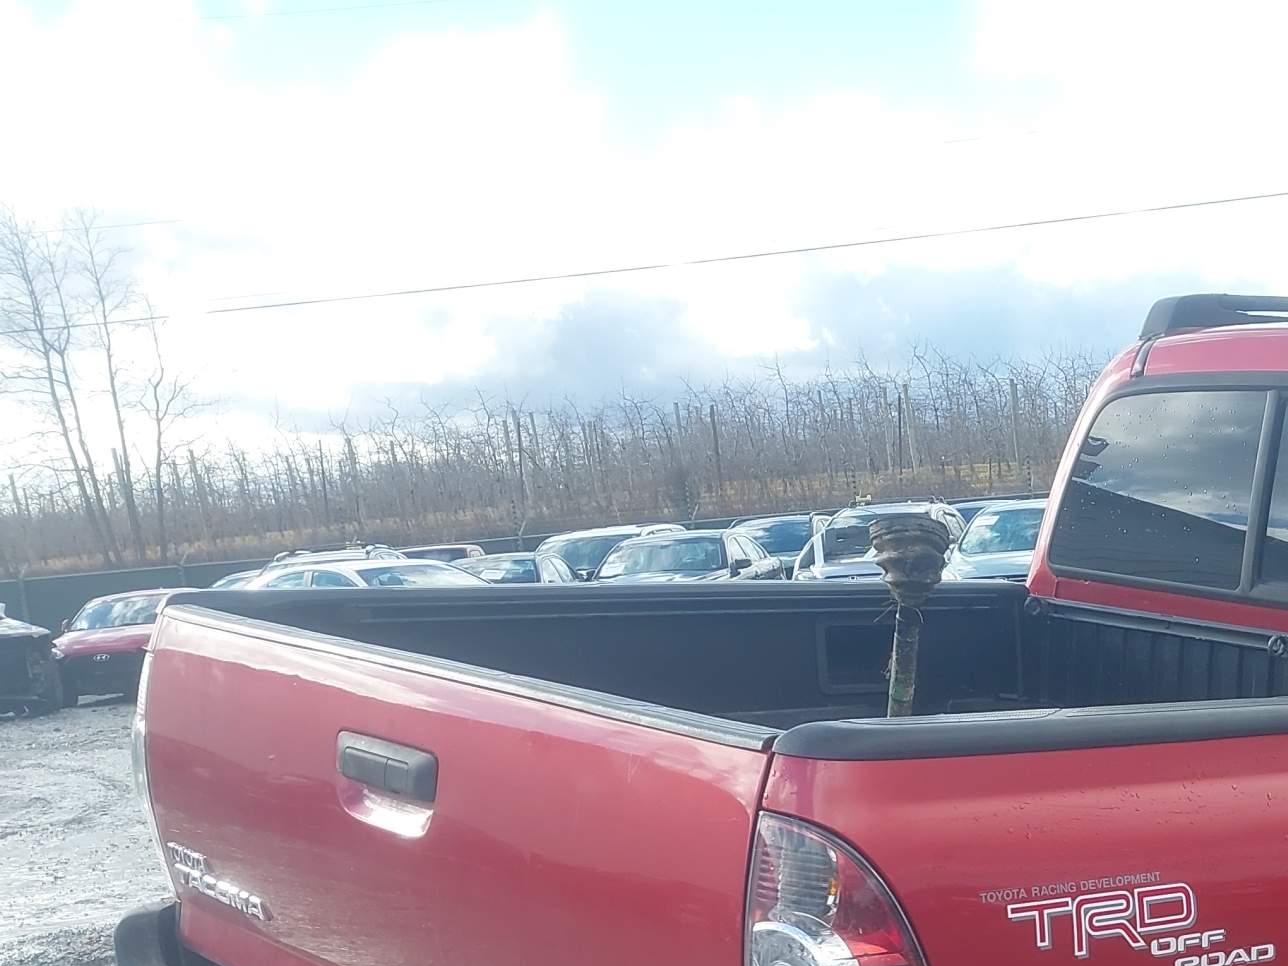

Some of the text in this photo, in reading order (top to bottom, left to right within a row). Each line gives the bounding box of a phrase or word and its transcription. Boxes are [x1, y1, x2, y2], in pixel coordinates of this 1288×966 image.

[174, 863, 264, 921] TACOMA
[979, 871, 1161, 904] TOYOTA RACING DEVELOPMENT
[1007, 881, 1196, 957] TRD
[1149, 928, 1226, 957] OFF
